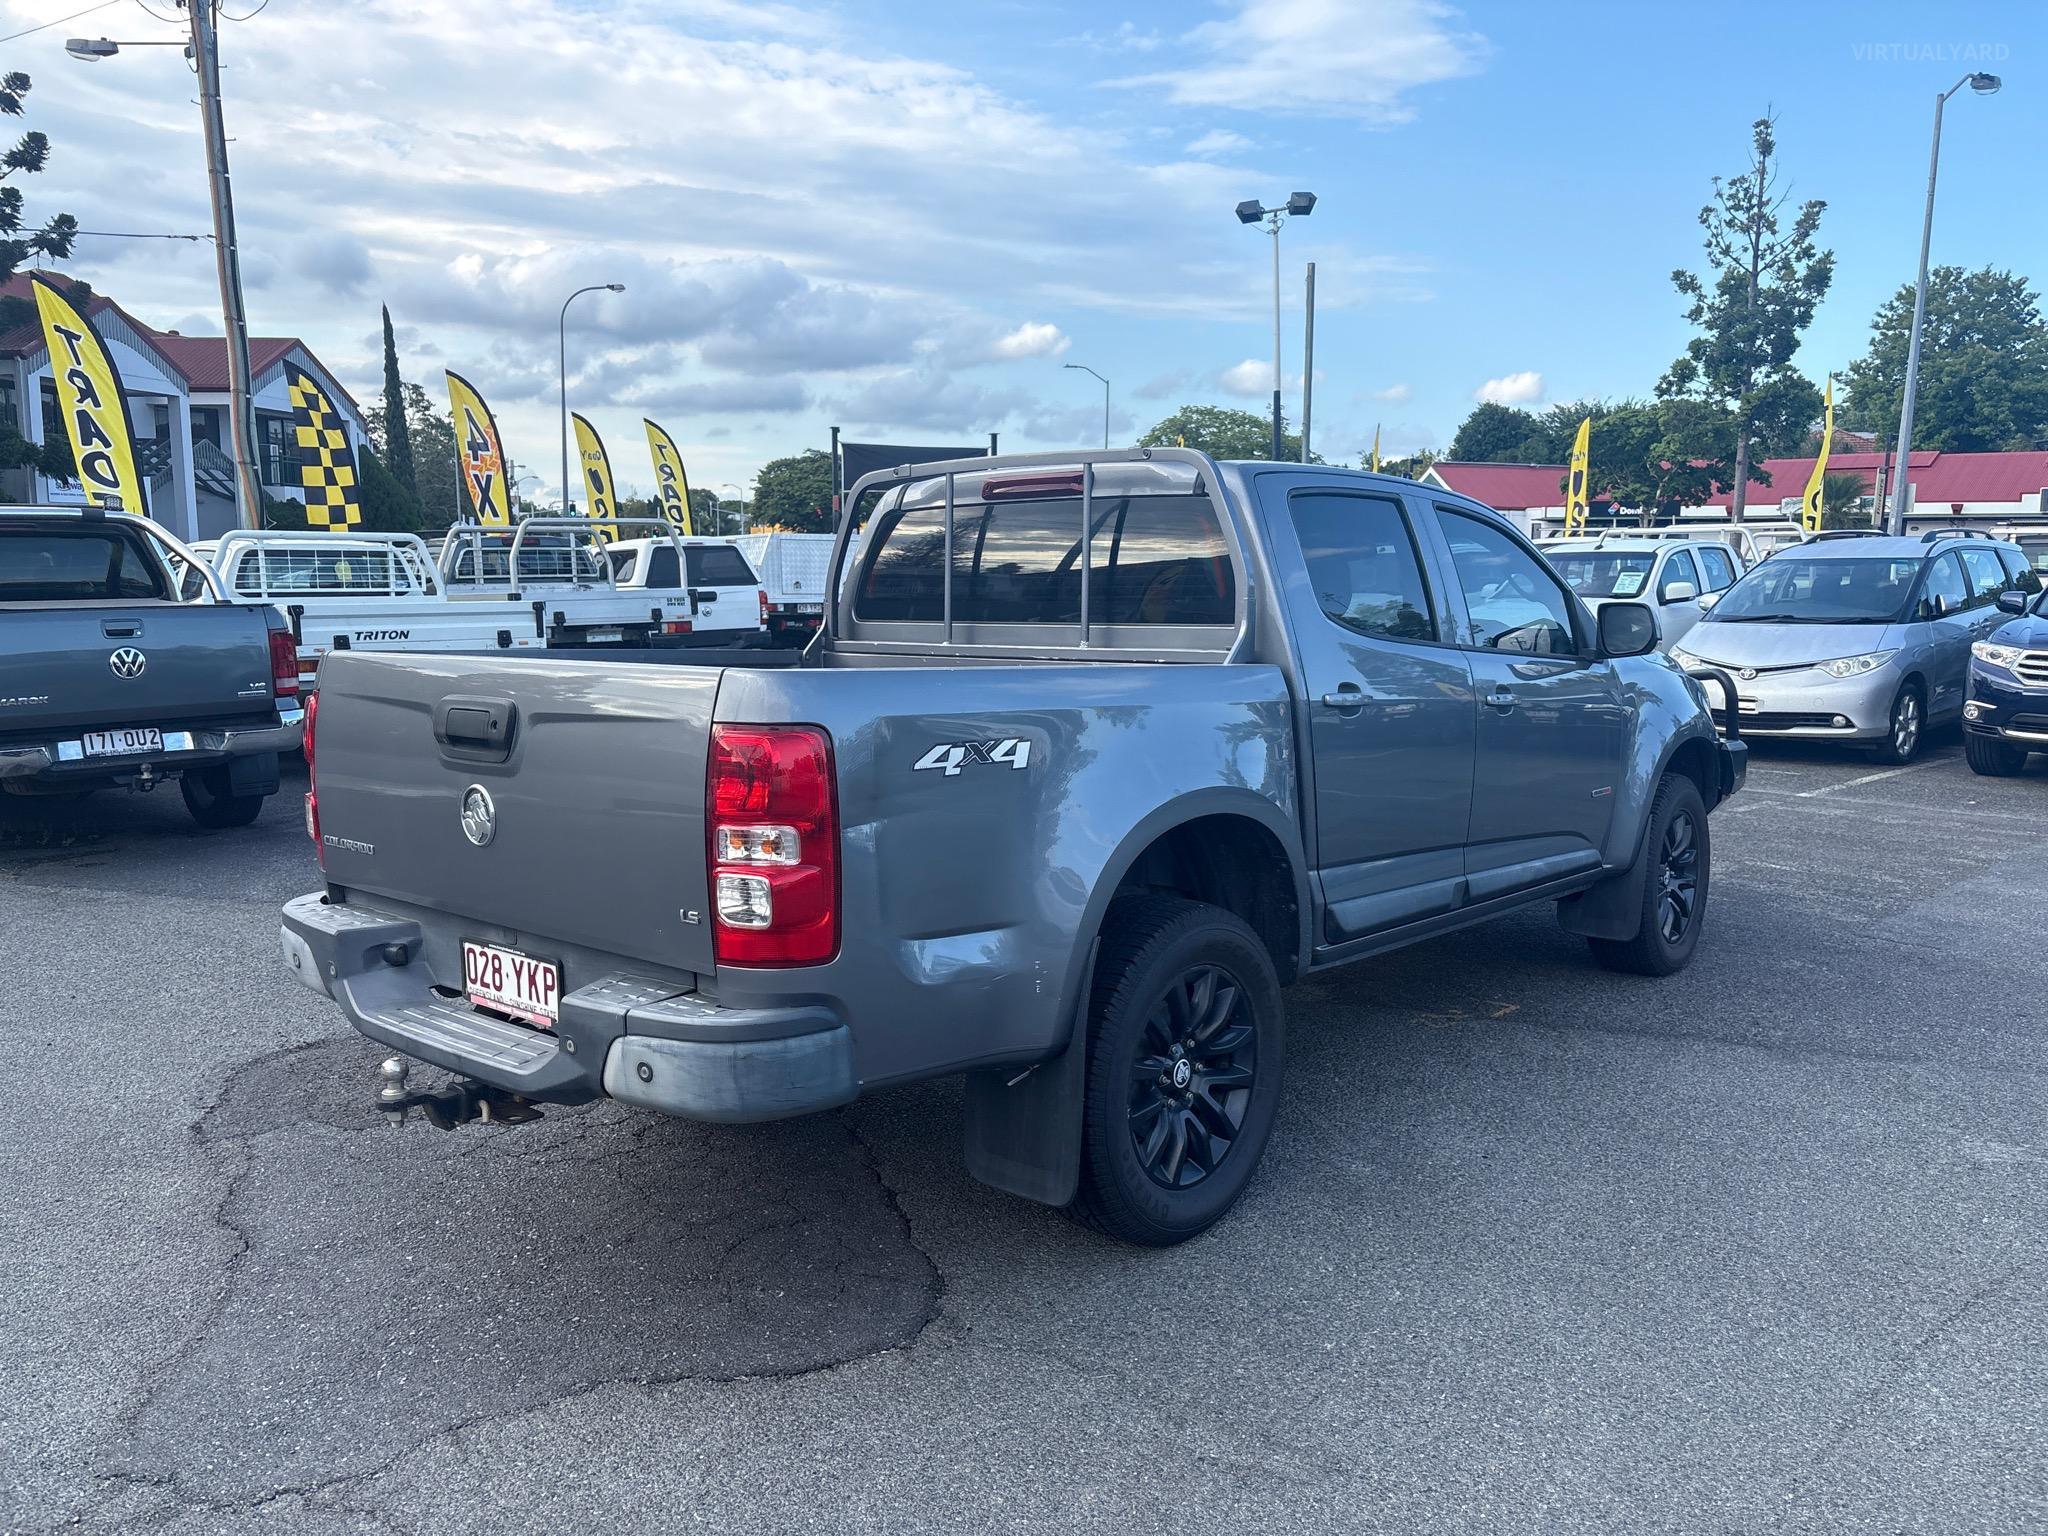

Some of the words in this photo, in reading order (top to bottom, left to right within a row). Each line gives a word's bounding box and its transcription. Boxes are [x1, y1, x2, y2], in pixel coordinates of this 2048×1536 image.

[354, 630, 410, 641] TRITON
[323, 834, 375, 855] COLORADO
[679, 908, 700, 925] LS
